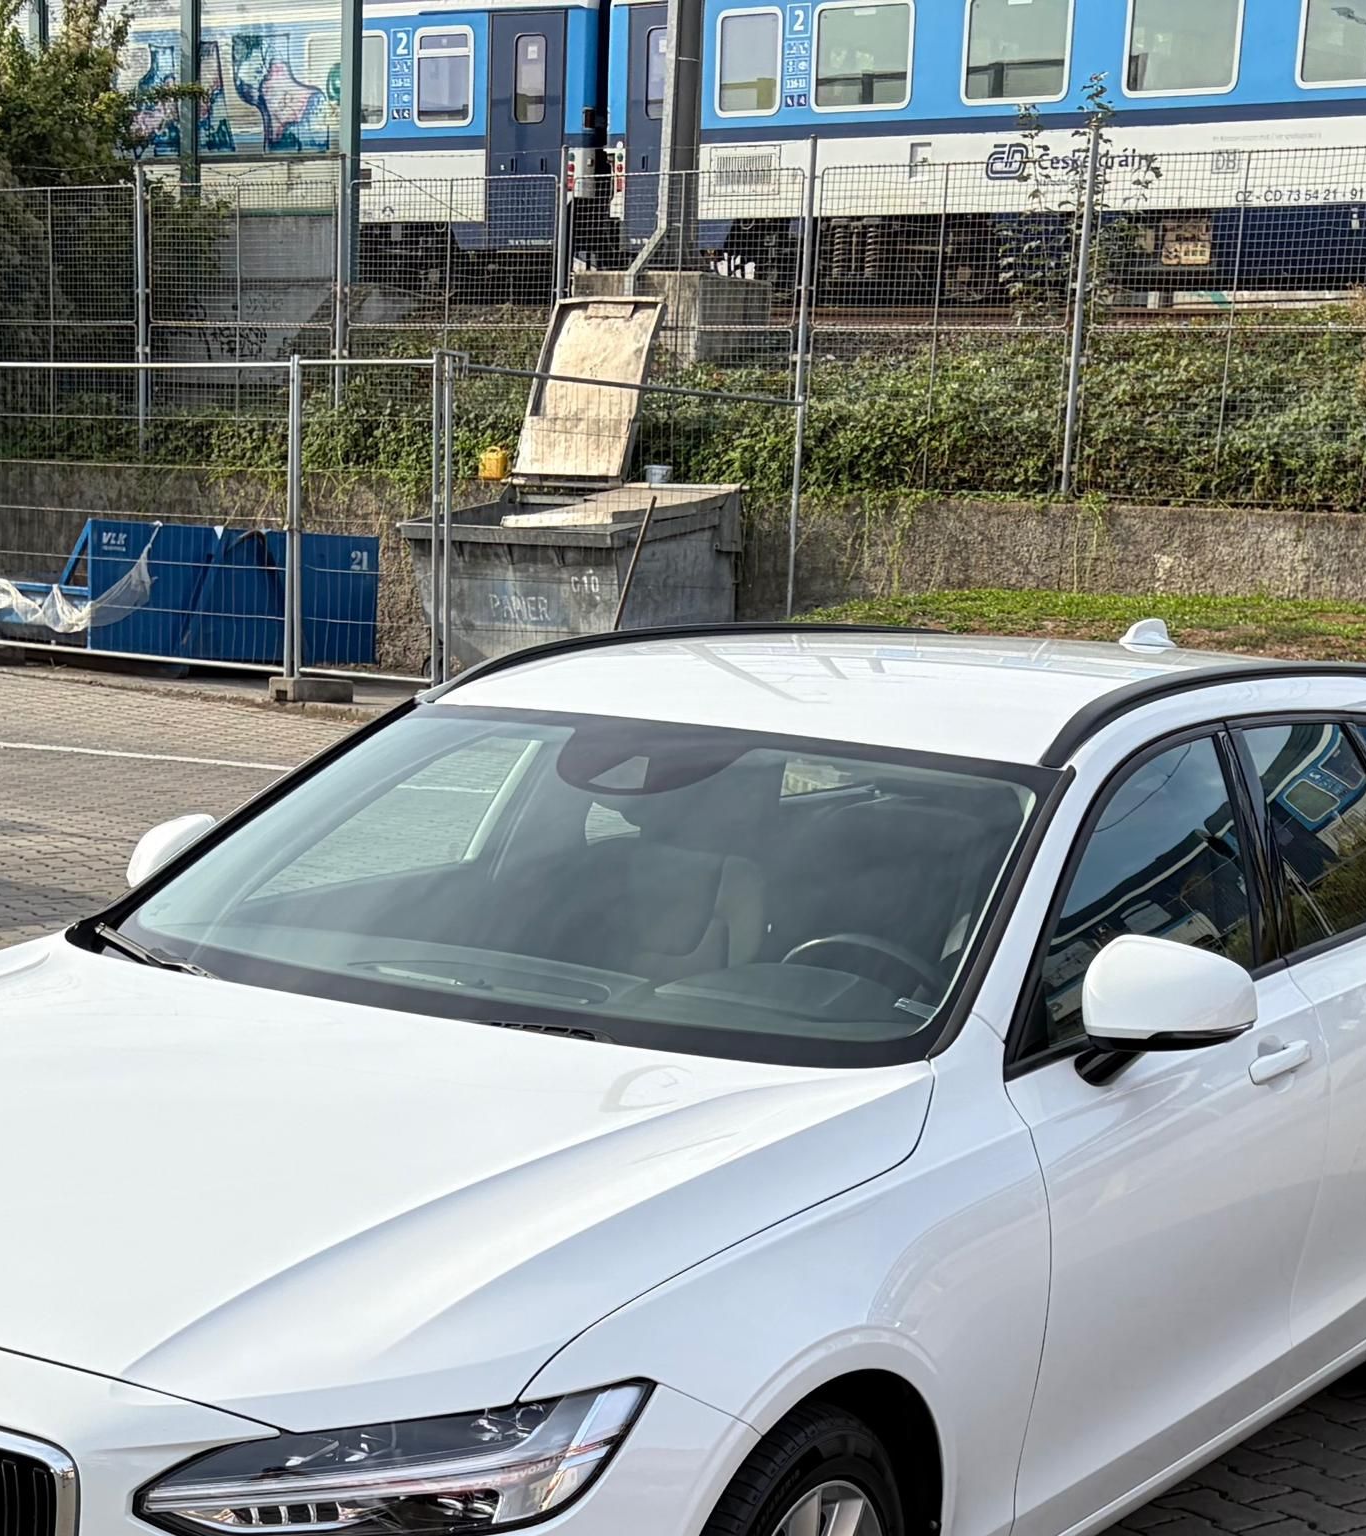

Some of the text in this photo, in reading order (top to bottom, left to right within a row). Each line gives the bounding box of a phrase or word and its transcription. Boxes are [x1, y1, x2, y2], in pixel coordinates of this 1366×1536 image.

[793, 9, 805, 32] 2
[395, 32, 409, 55] 2
[350, 550, 369, 571] 21
